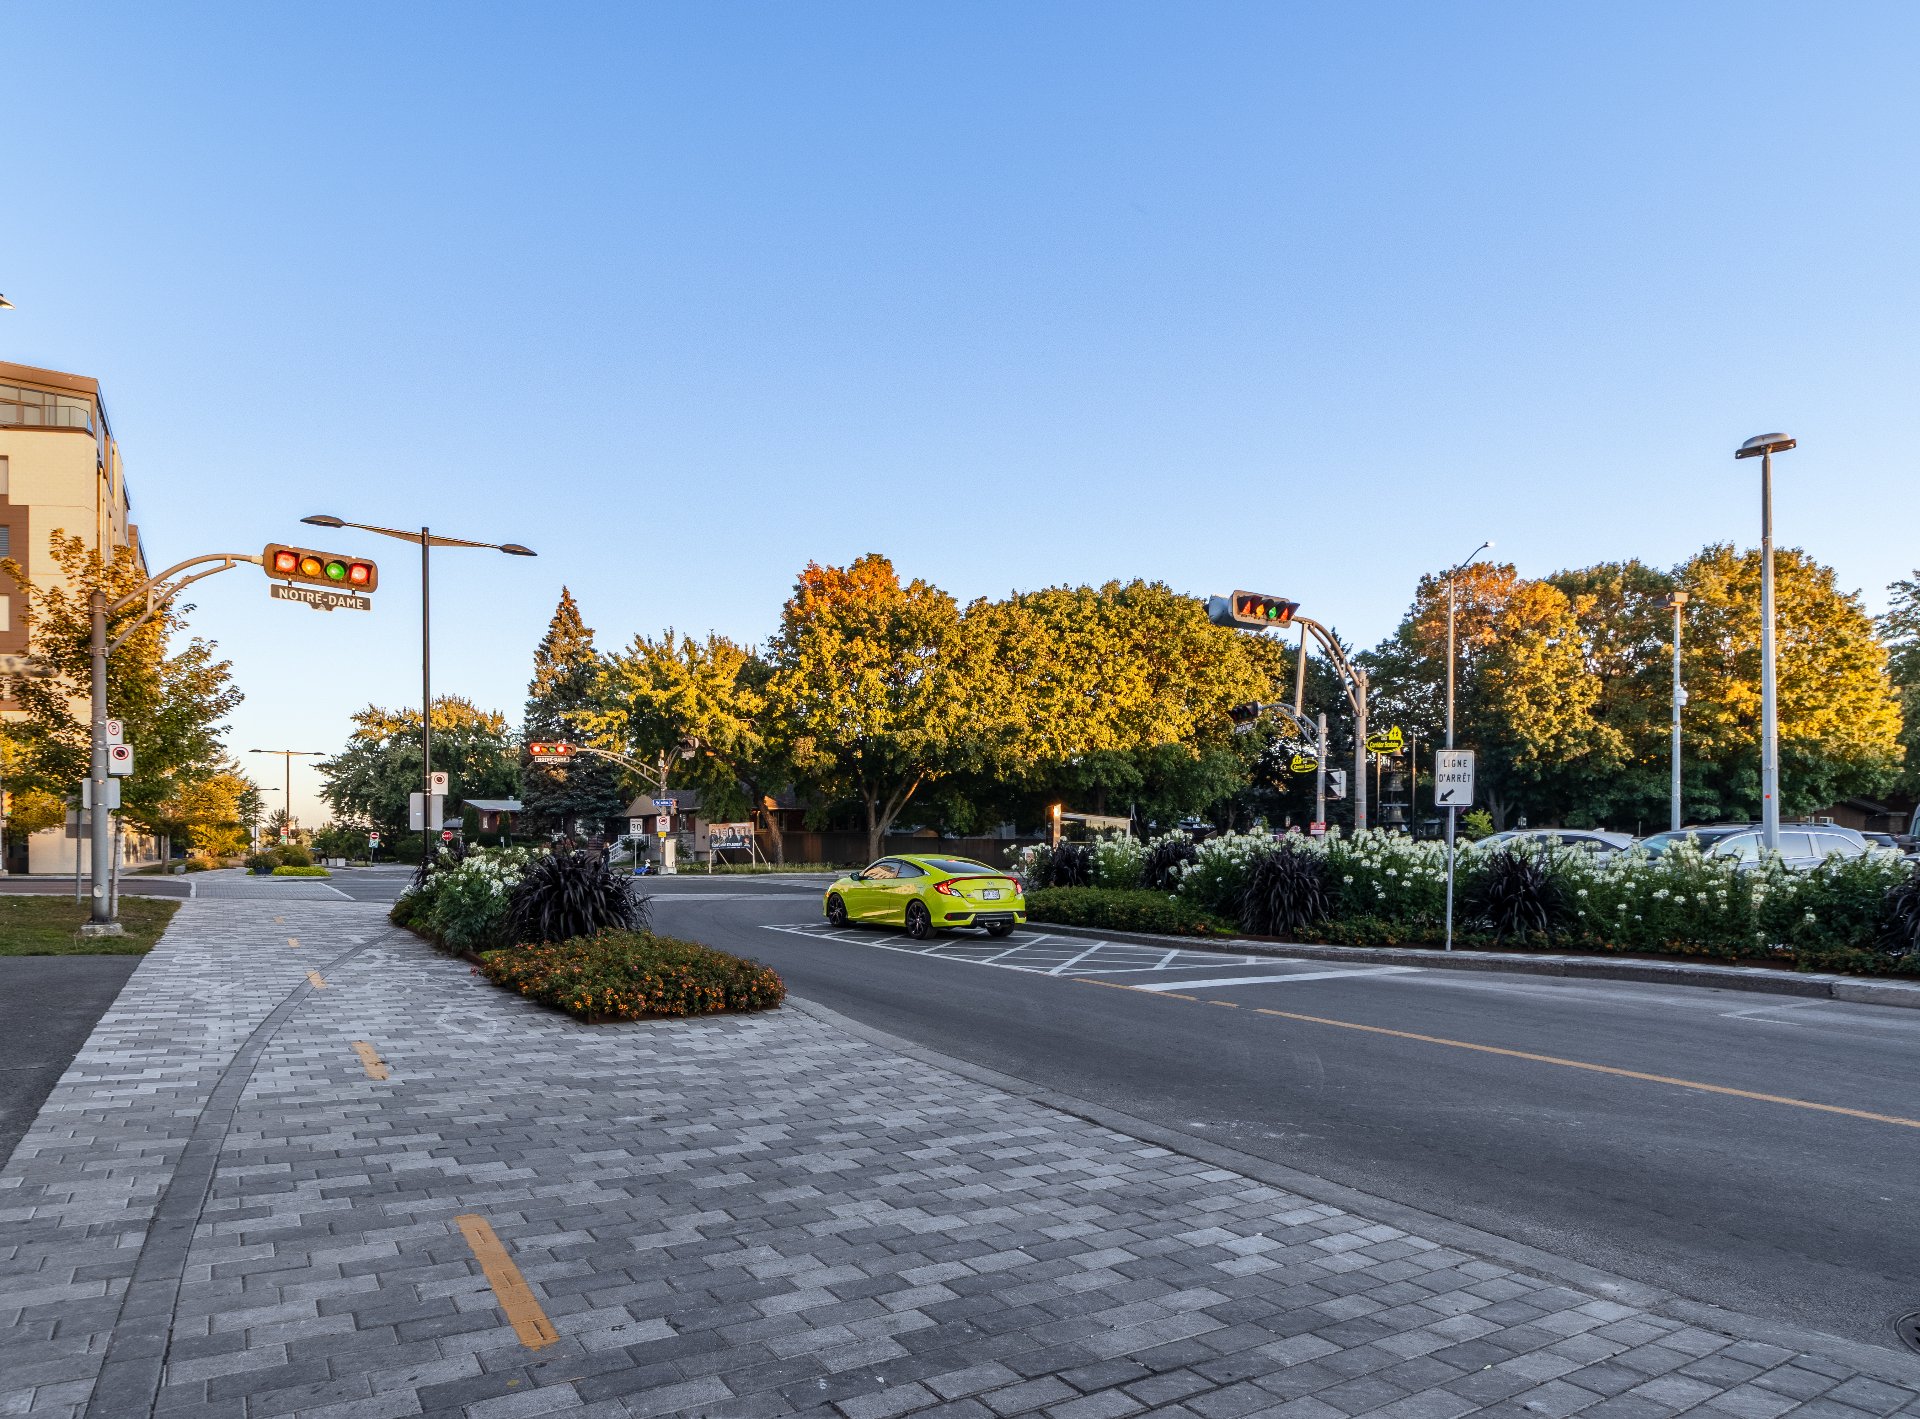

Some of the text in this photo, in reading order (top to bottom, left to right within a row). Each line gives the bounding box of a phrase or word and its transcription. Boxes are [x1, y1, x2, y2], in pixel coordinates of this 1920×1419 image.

[279, 588, 364, 609] NOTRE-DAME
[1443, 759, 1467, 768] LIGNE
[1438, 772, 1471, 783] D'ARRÊT
[631, 823, 642, 832] 30
